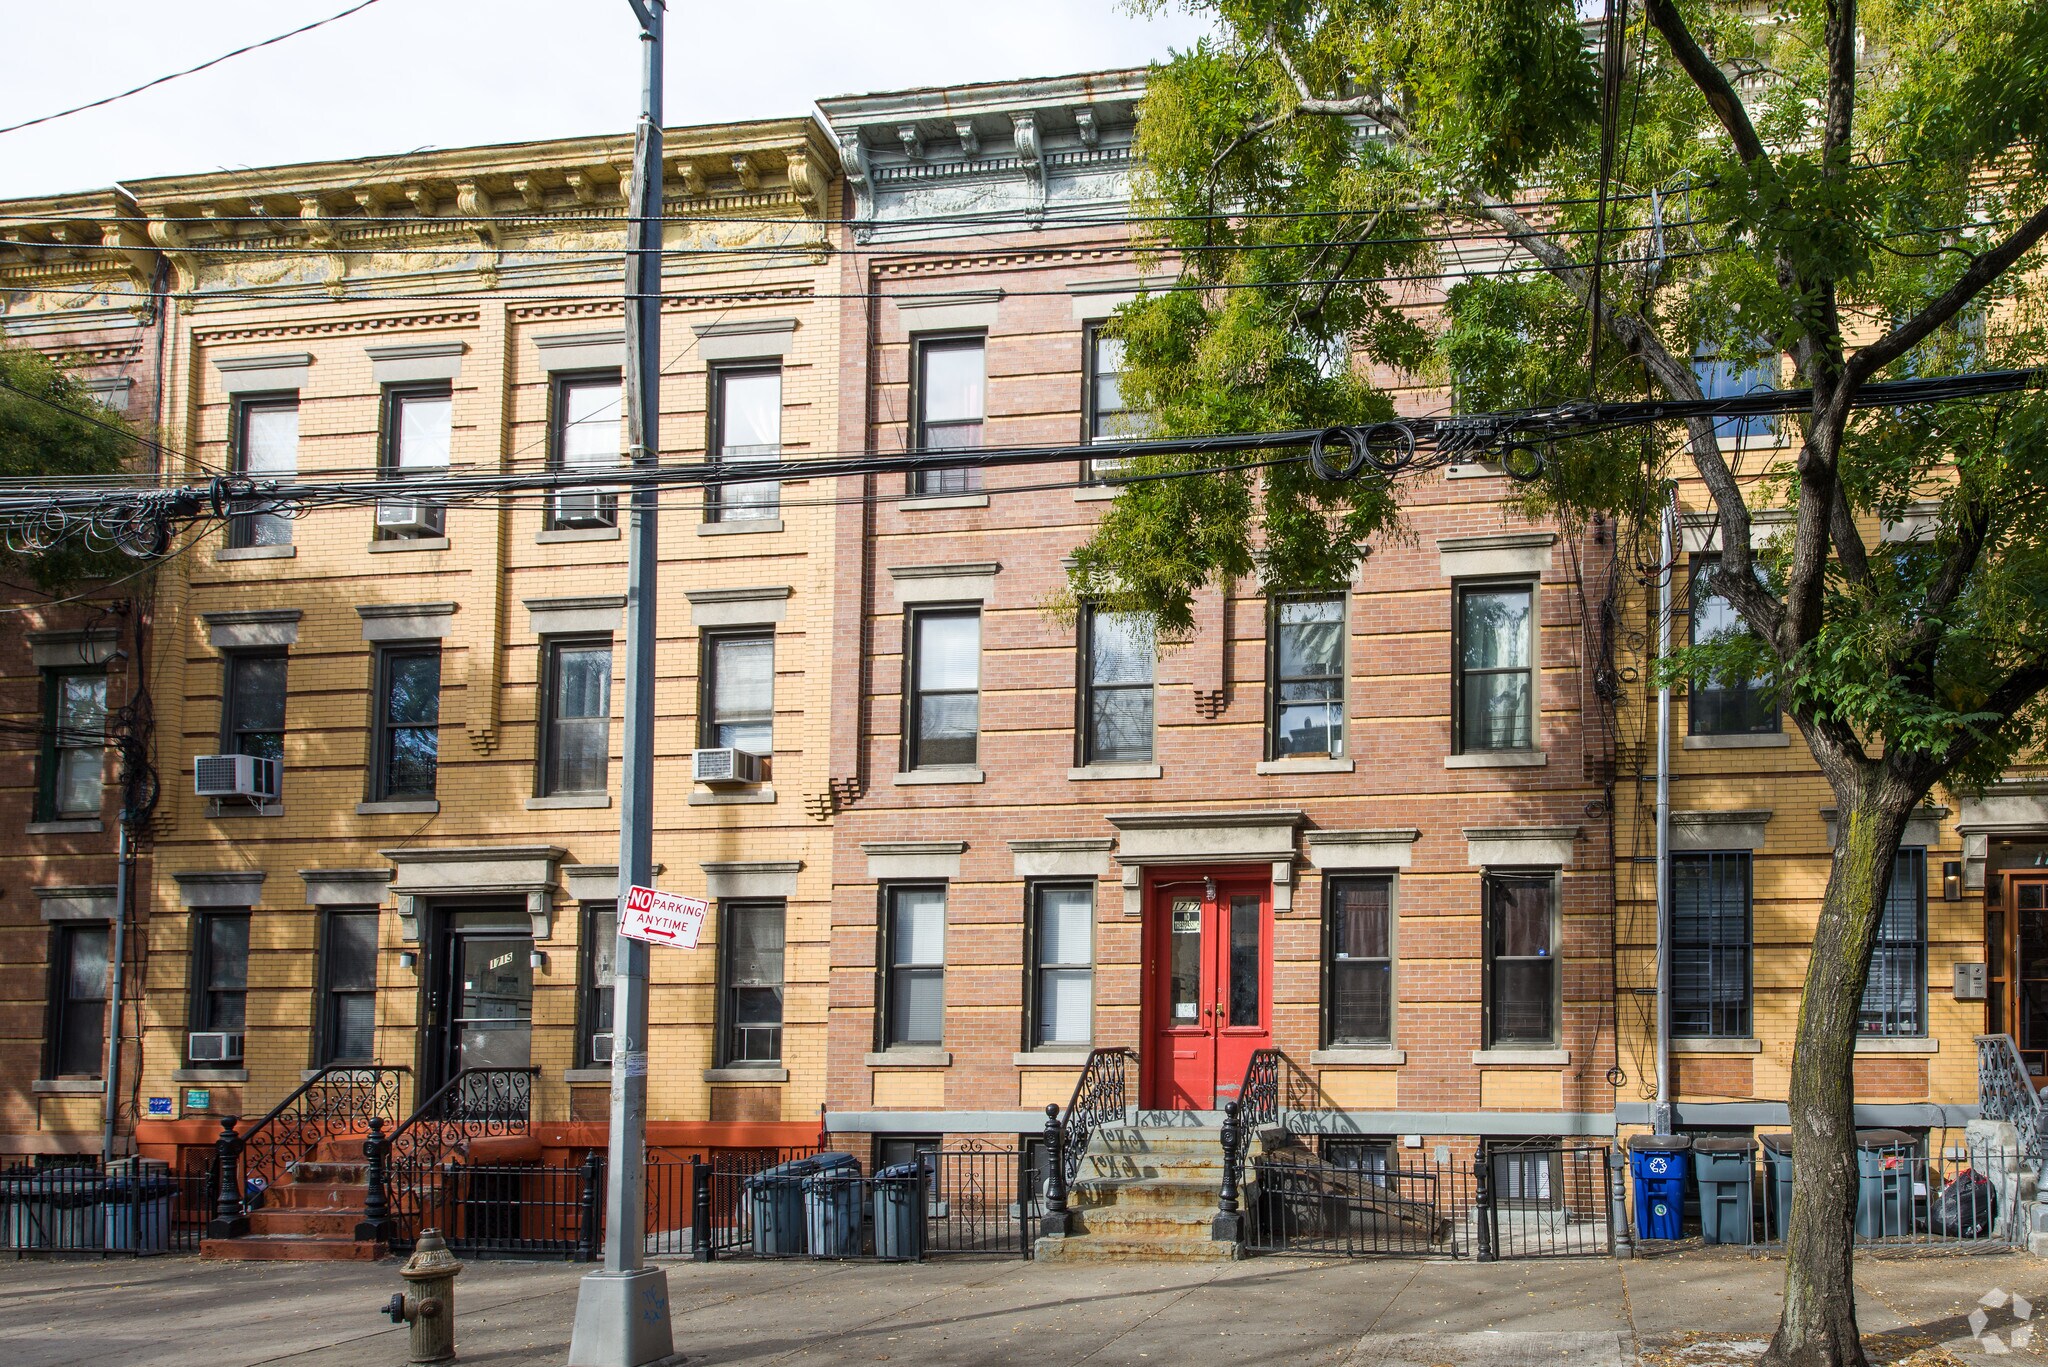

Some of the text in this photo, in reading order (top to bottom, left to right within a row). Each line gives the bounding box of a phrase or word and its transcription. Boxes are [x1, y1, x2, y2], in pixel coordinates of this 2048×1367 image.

[629, 889, 702, 917] NO PARKING
[1174, 902, 1199, 910] 1717
[636, 913, 689, 932] ANYTIME
